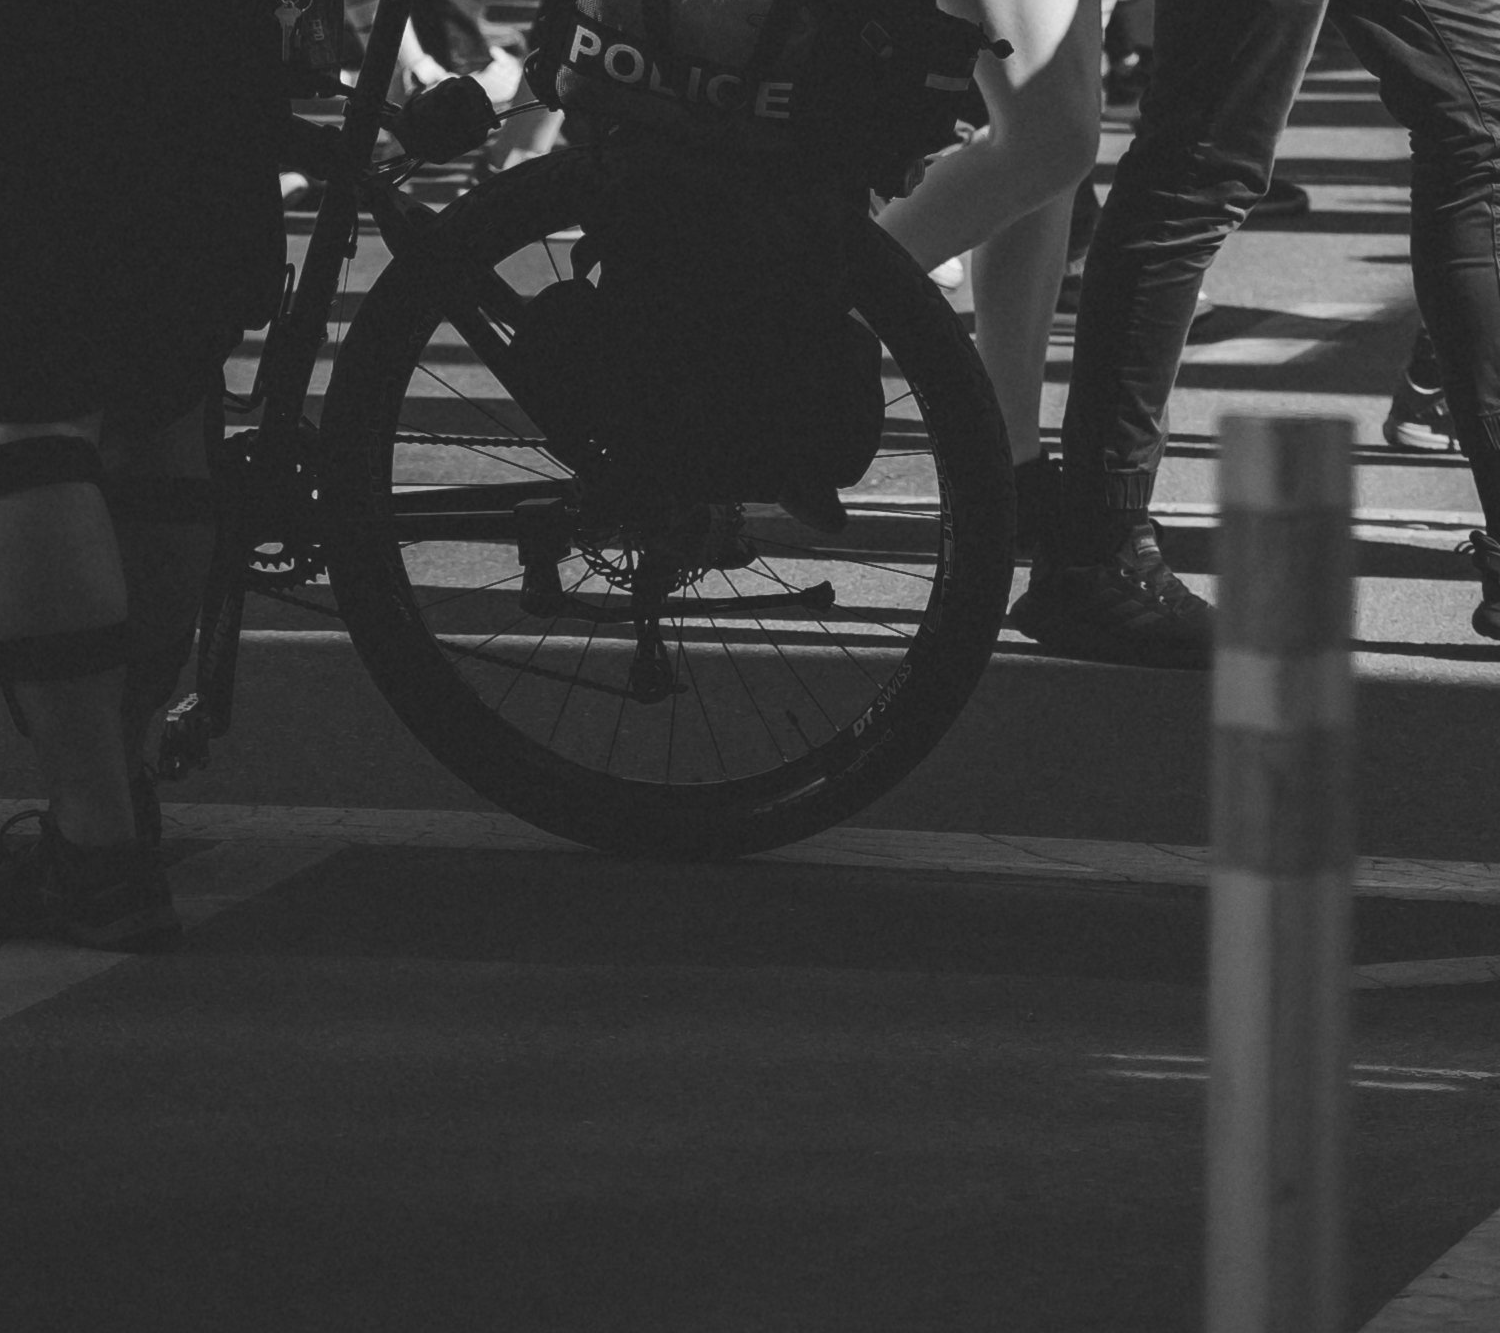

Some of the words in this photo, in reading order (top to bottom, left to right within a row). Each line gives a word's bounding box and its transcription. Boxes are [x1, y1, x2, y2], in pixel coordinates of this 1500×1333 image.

[569, 24, 794, 119] POLICE
[851, 710, 874, 737] DT
[875, 661, 913, 713] SWISS
